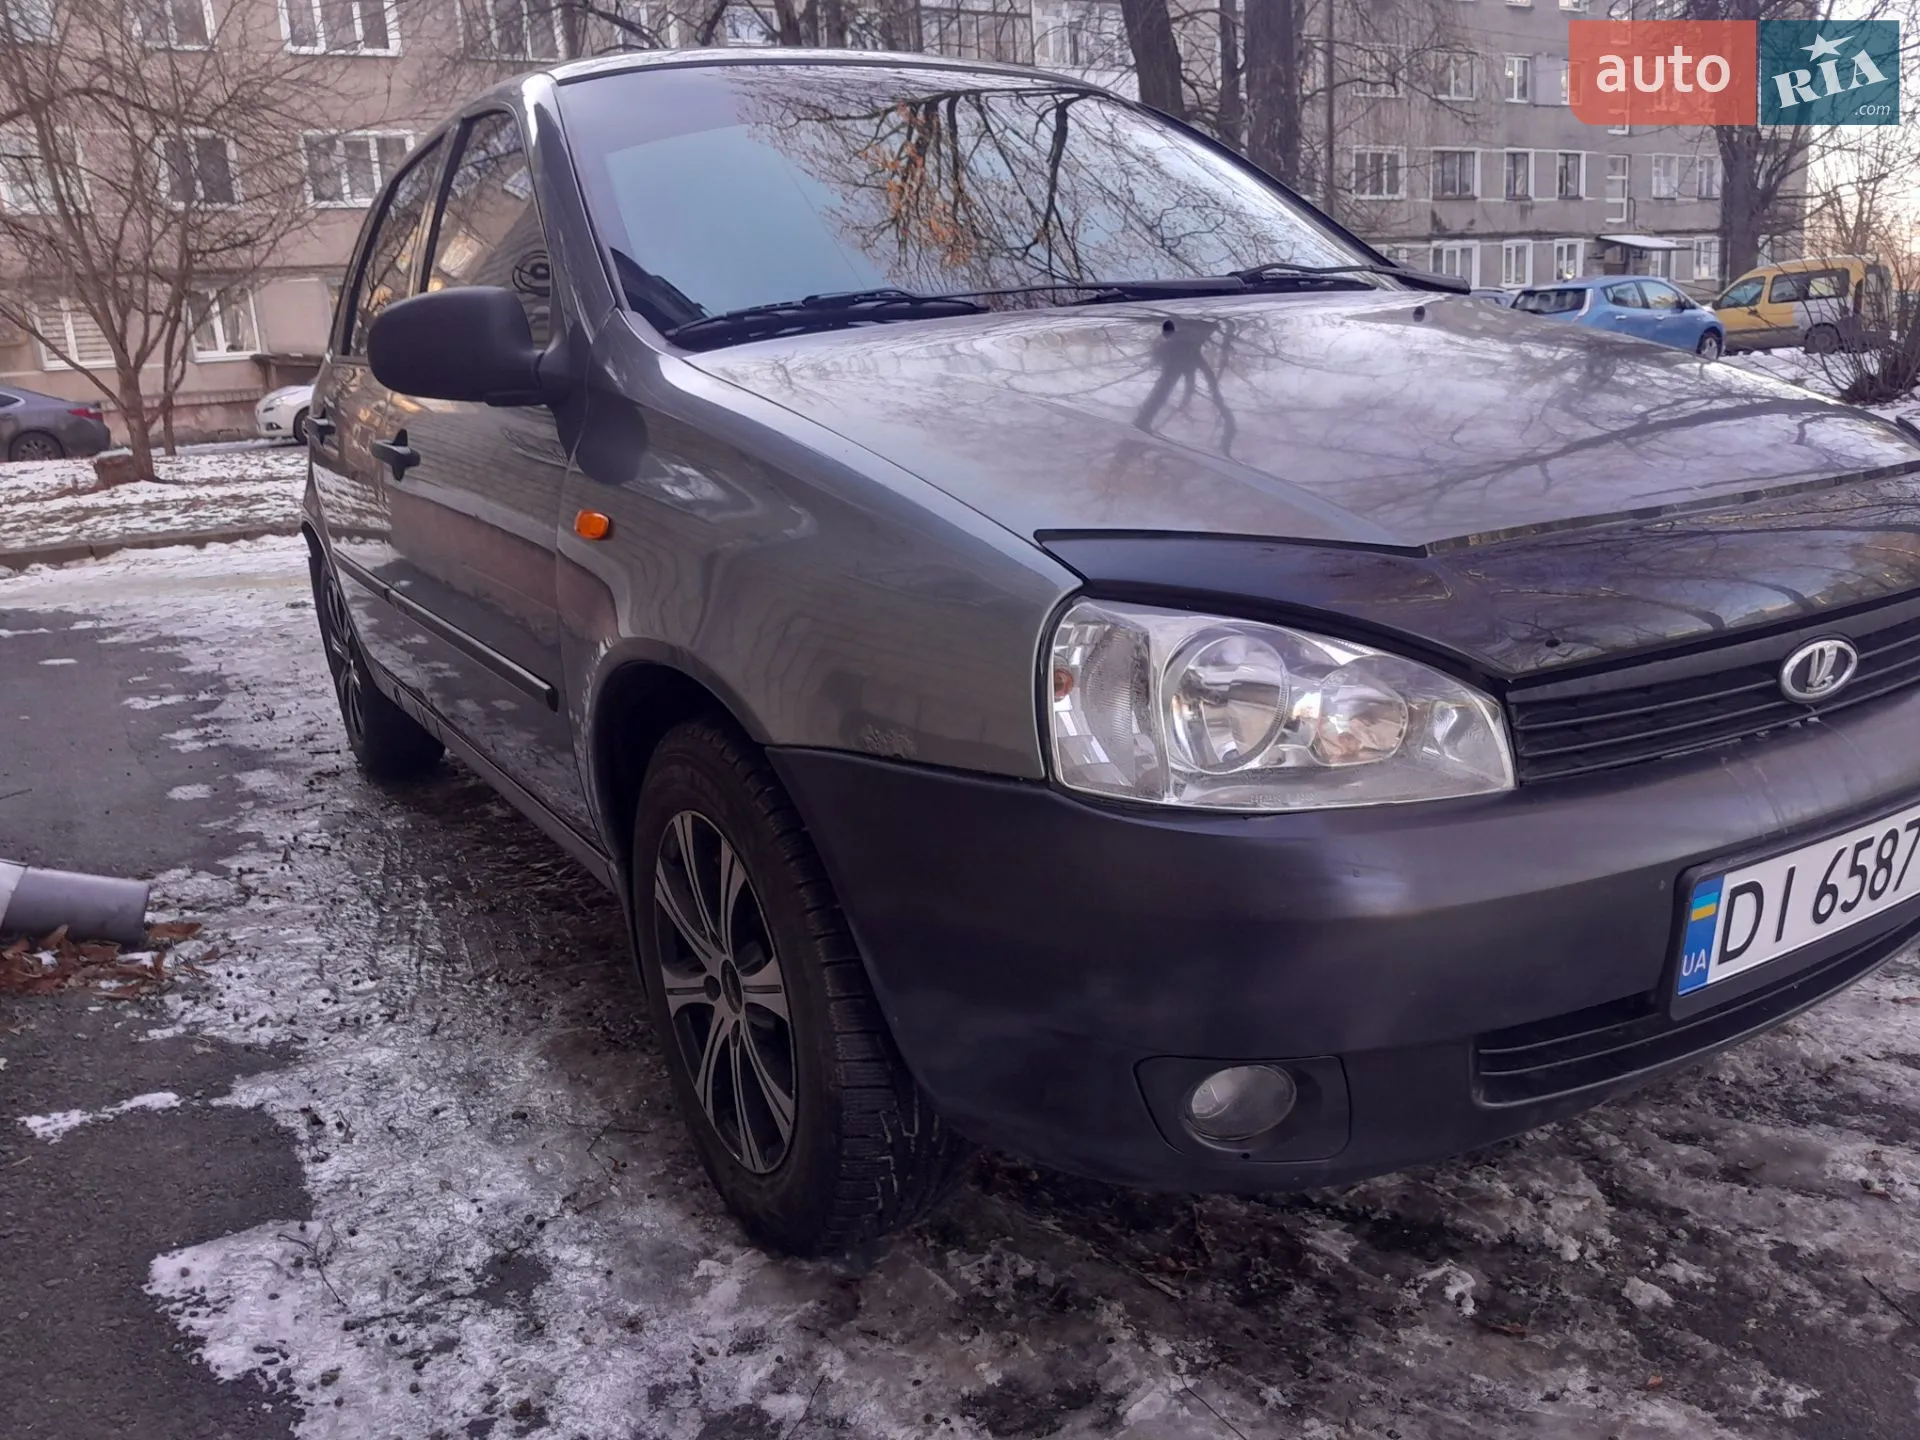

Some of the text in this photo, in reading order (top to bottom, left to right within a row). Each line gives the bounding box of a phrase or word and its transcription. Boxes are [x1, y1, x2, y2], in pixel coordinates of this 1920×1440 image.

[1718, 819, 1920, 966] DI 6587
[1682, 949, 1707, 976] UA
